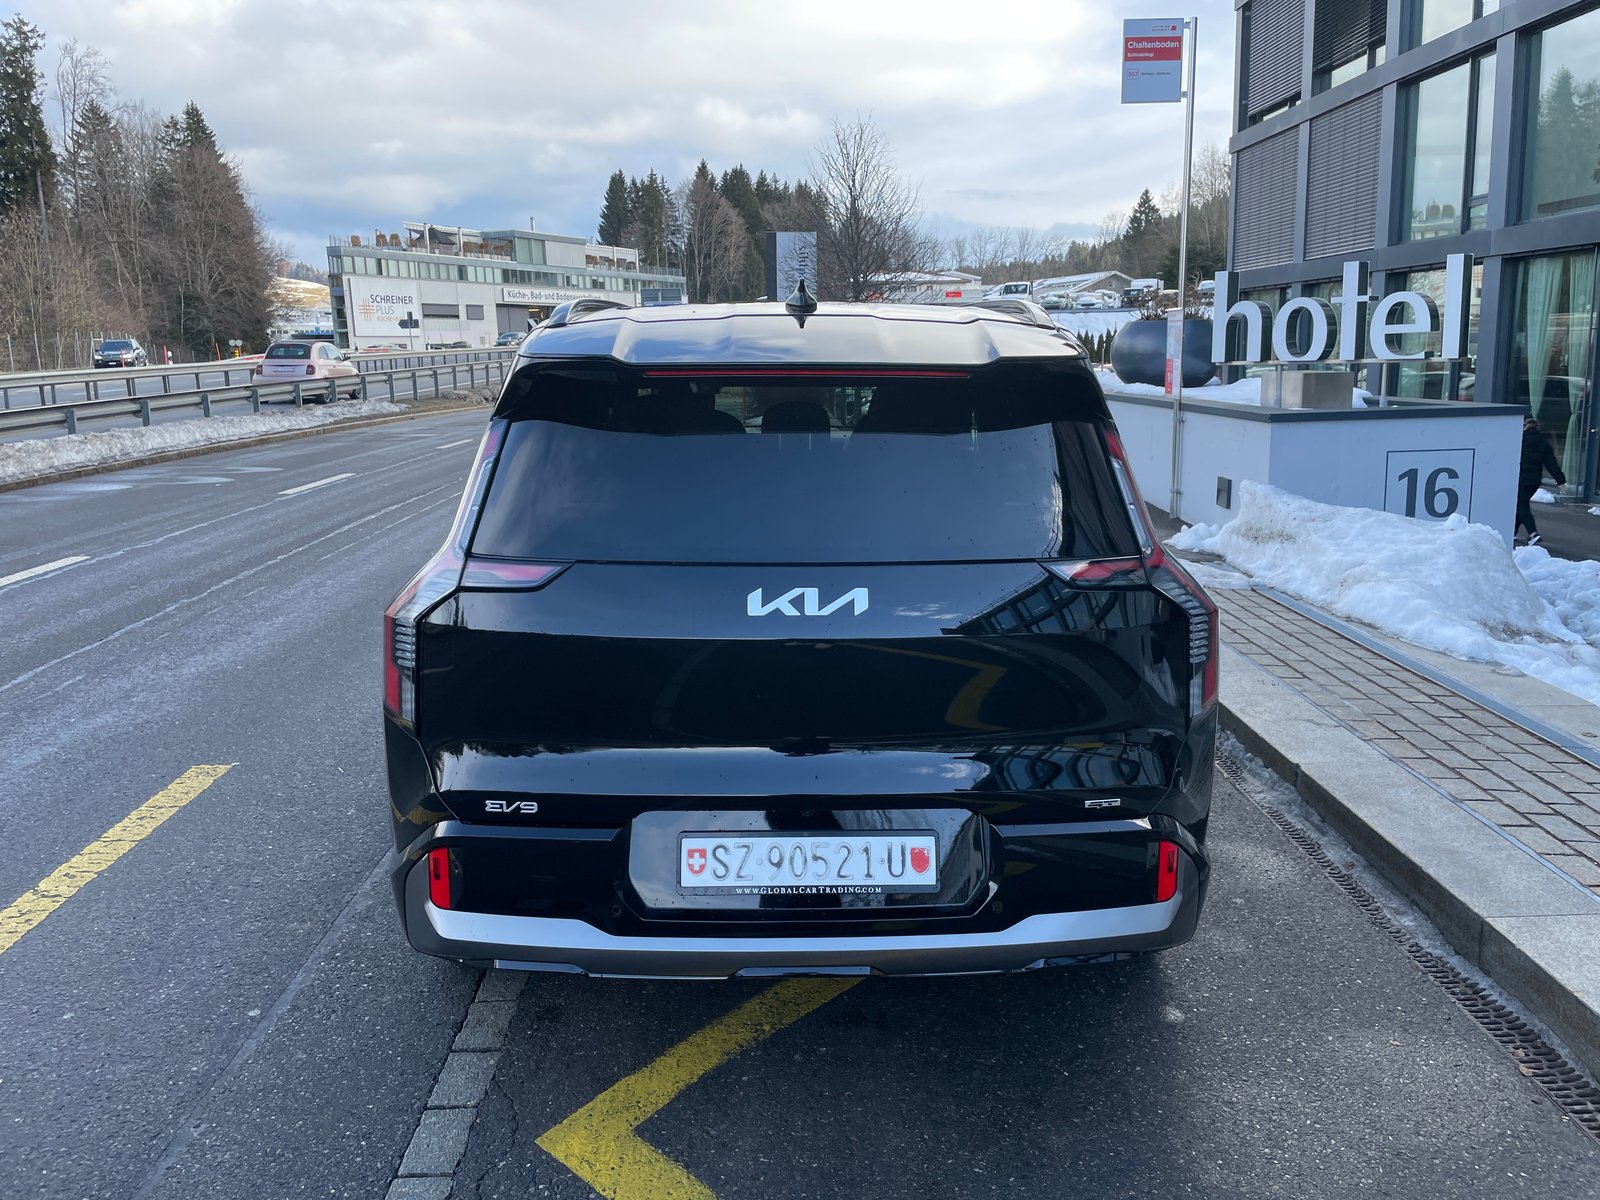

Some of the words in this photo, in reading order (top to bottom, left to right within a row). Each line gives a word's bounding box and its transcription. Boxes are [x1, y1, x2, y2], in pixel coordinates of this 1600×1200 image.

[1127, 41, 1180, 49] Chaltenboden
[370, 294, 414, 305] SCHREINER
[545, 292, 555, 301] und
[376, 305, 395, 315] PLUS
[1211, 253, 1474, 363] hotel
[1397, 467, 1460, 519] 16
[747, 587, 869, 616] KIA
[485, 800, 538, 814] EV9
